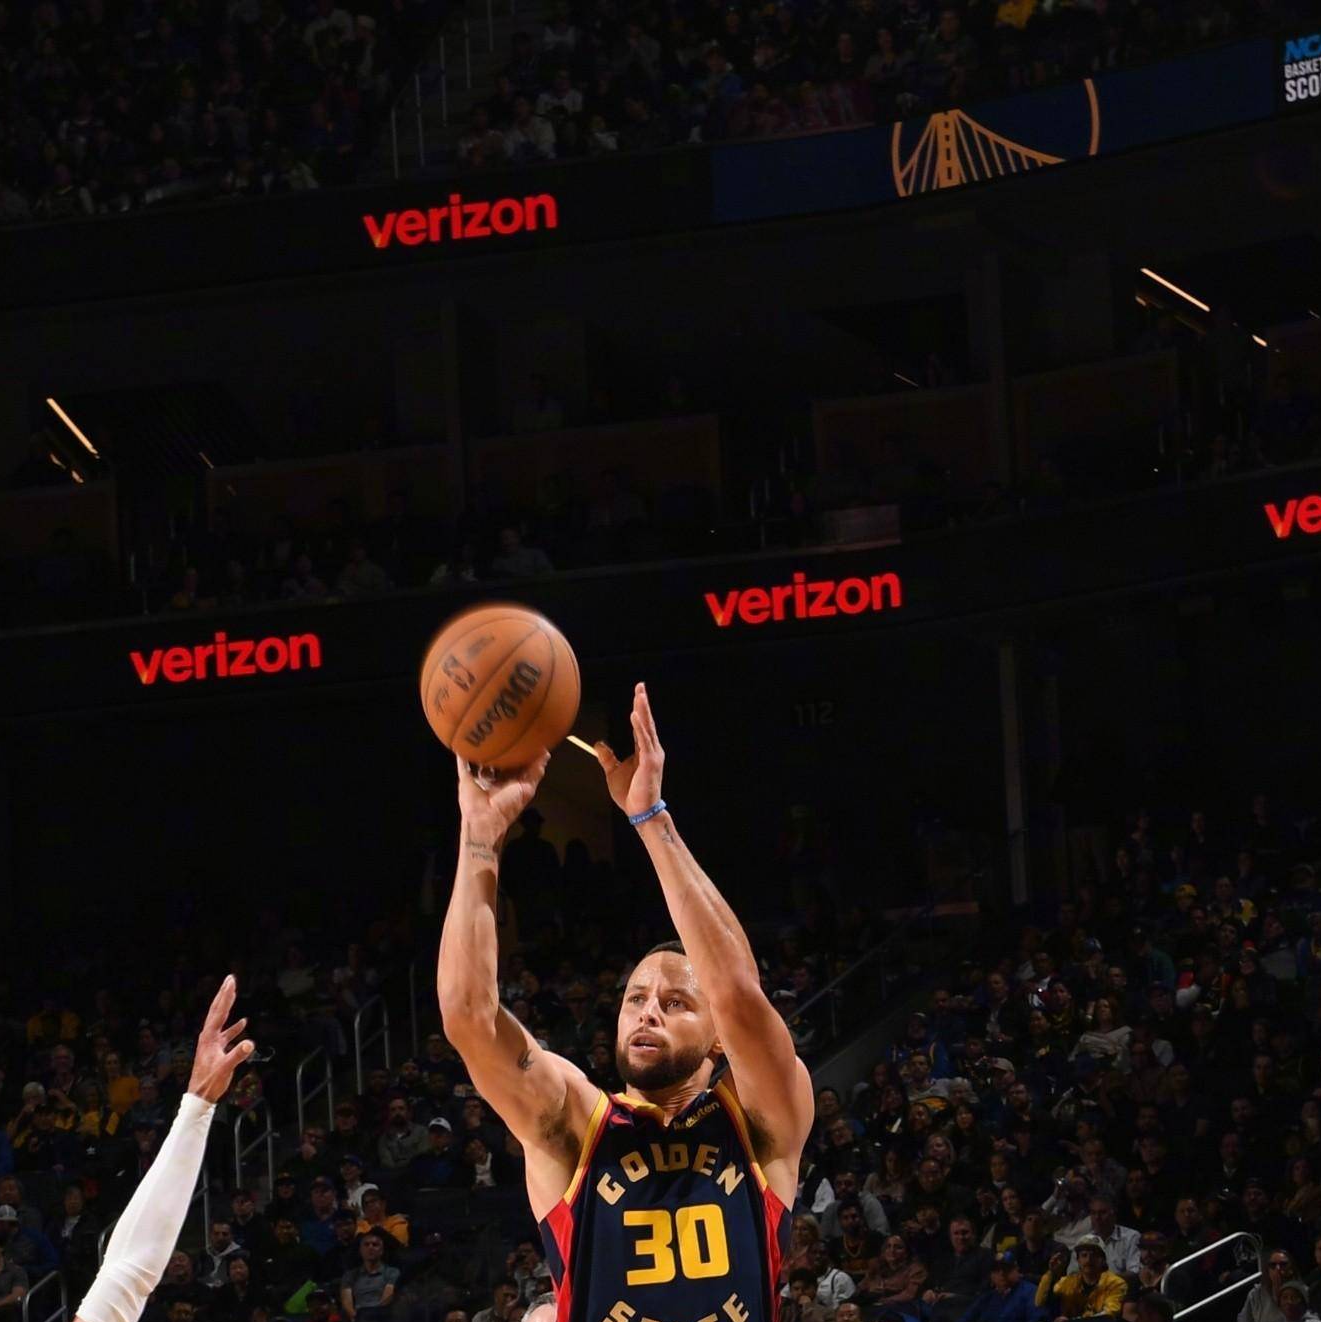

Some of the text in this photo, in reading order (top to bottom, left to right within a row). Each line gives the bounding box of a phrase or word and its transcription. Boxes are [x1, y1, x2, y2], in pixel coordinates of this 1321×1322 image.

[363, 193, 558, 249] verizon
[704, 571, 902, 628] verizon
[129, 630, 322, 686] verizon
[596, 1142, 746, 1206] GOLDEN
[622, 1203, 730, 1287] 30
